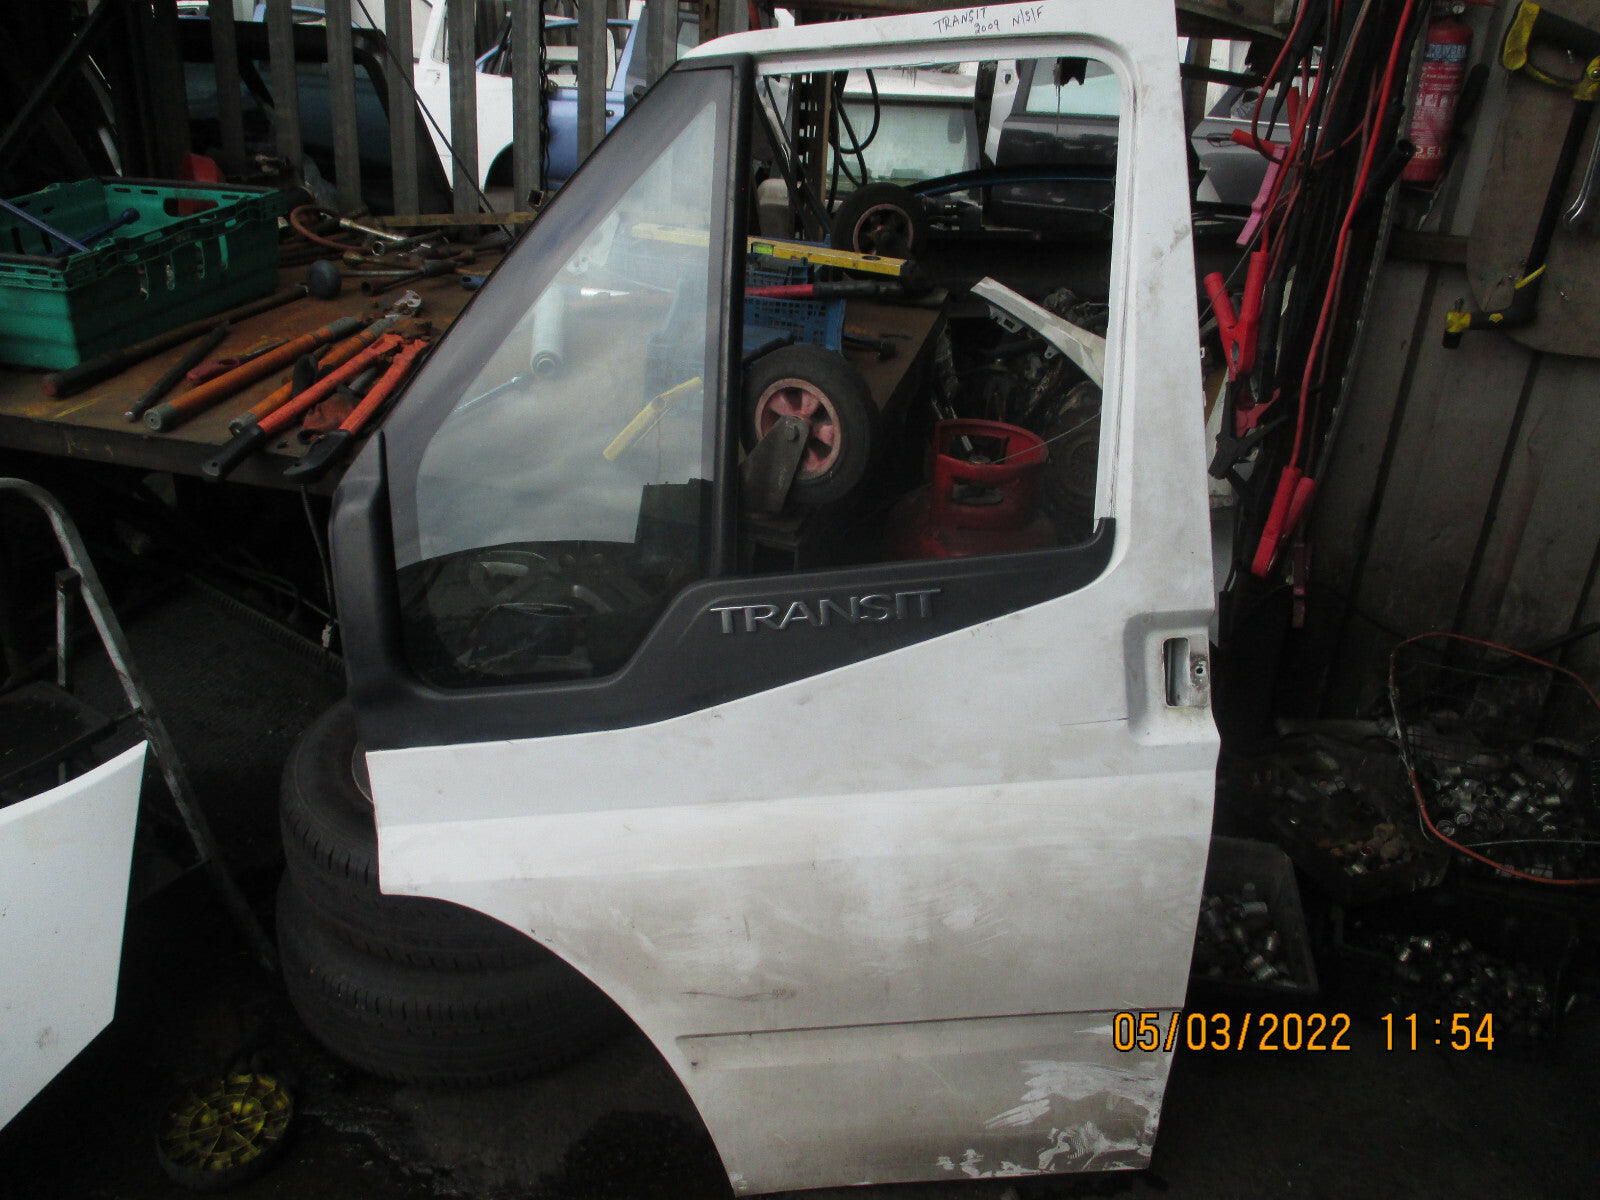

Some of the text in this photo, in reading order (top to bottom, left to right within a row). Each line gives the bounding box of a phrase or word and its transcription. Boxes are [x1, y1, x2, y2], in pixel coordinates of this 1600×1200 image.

[933, 7, 987, 34] TRANSIT
[974, 19, 1000, 34] 2009
[710, 588, 941, 634] TRANSIT
